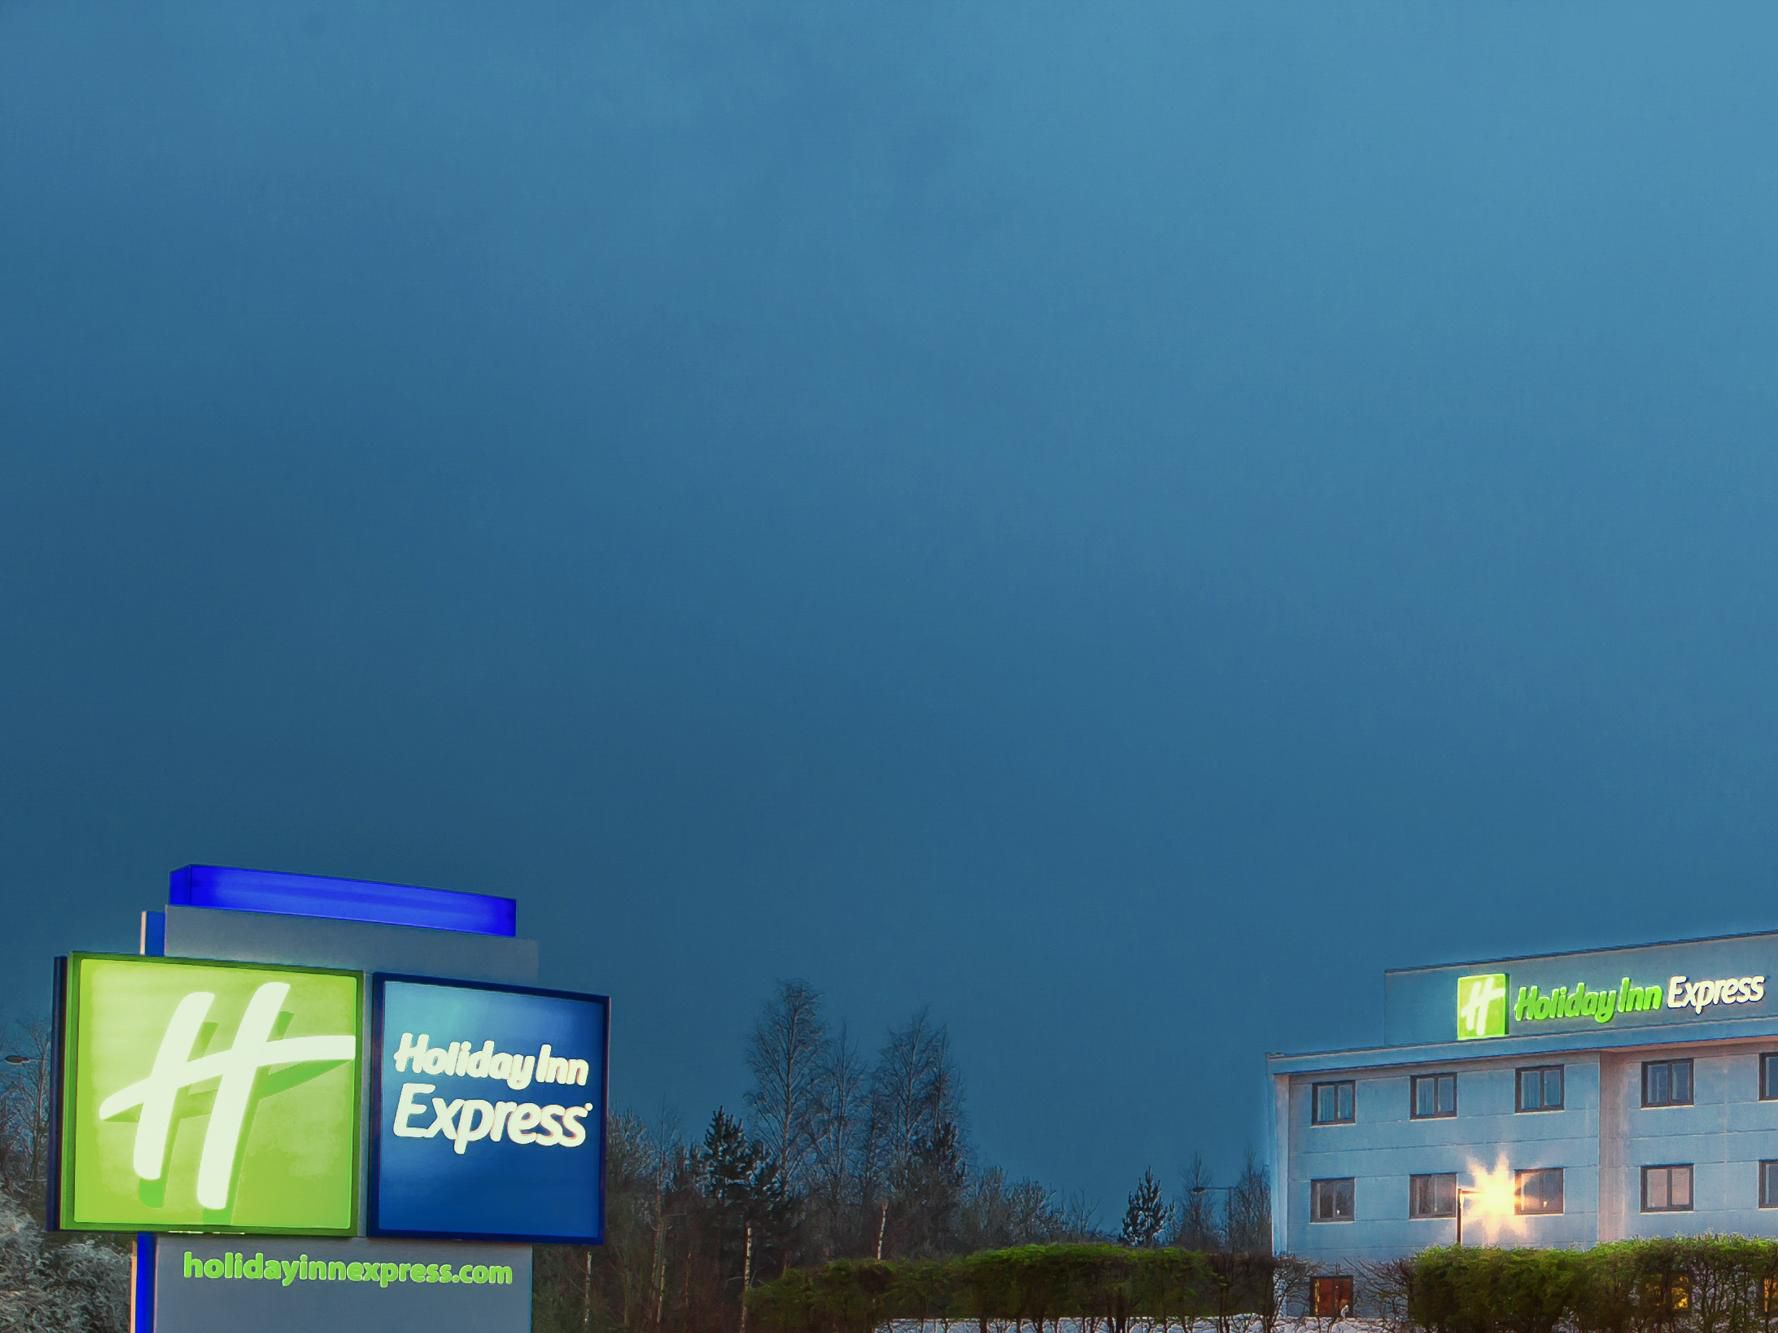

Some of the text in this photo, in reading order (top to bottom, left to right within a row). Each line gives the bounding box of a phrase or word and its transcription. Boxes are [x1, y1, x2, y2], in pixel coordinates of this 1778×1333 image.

[1514, 975, 1766, 1024] Holiday Inn Express
[393, 1032, 590, 1090] Holiday Inn
[393, 1082, 589, 1155] Express
[183, 1251, 513, 1288] holidayinnexpress.com
